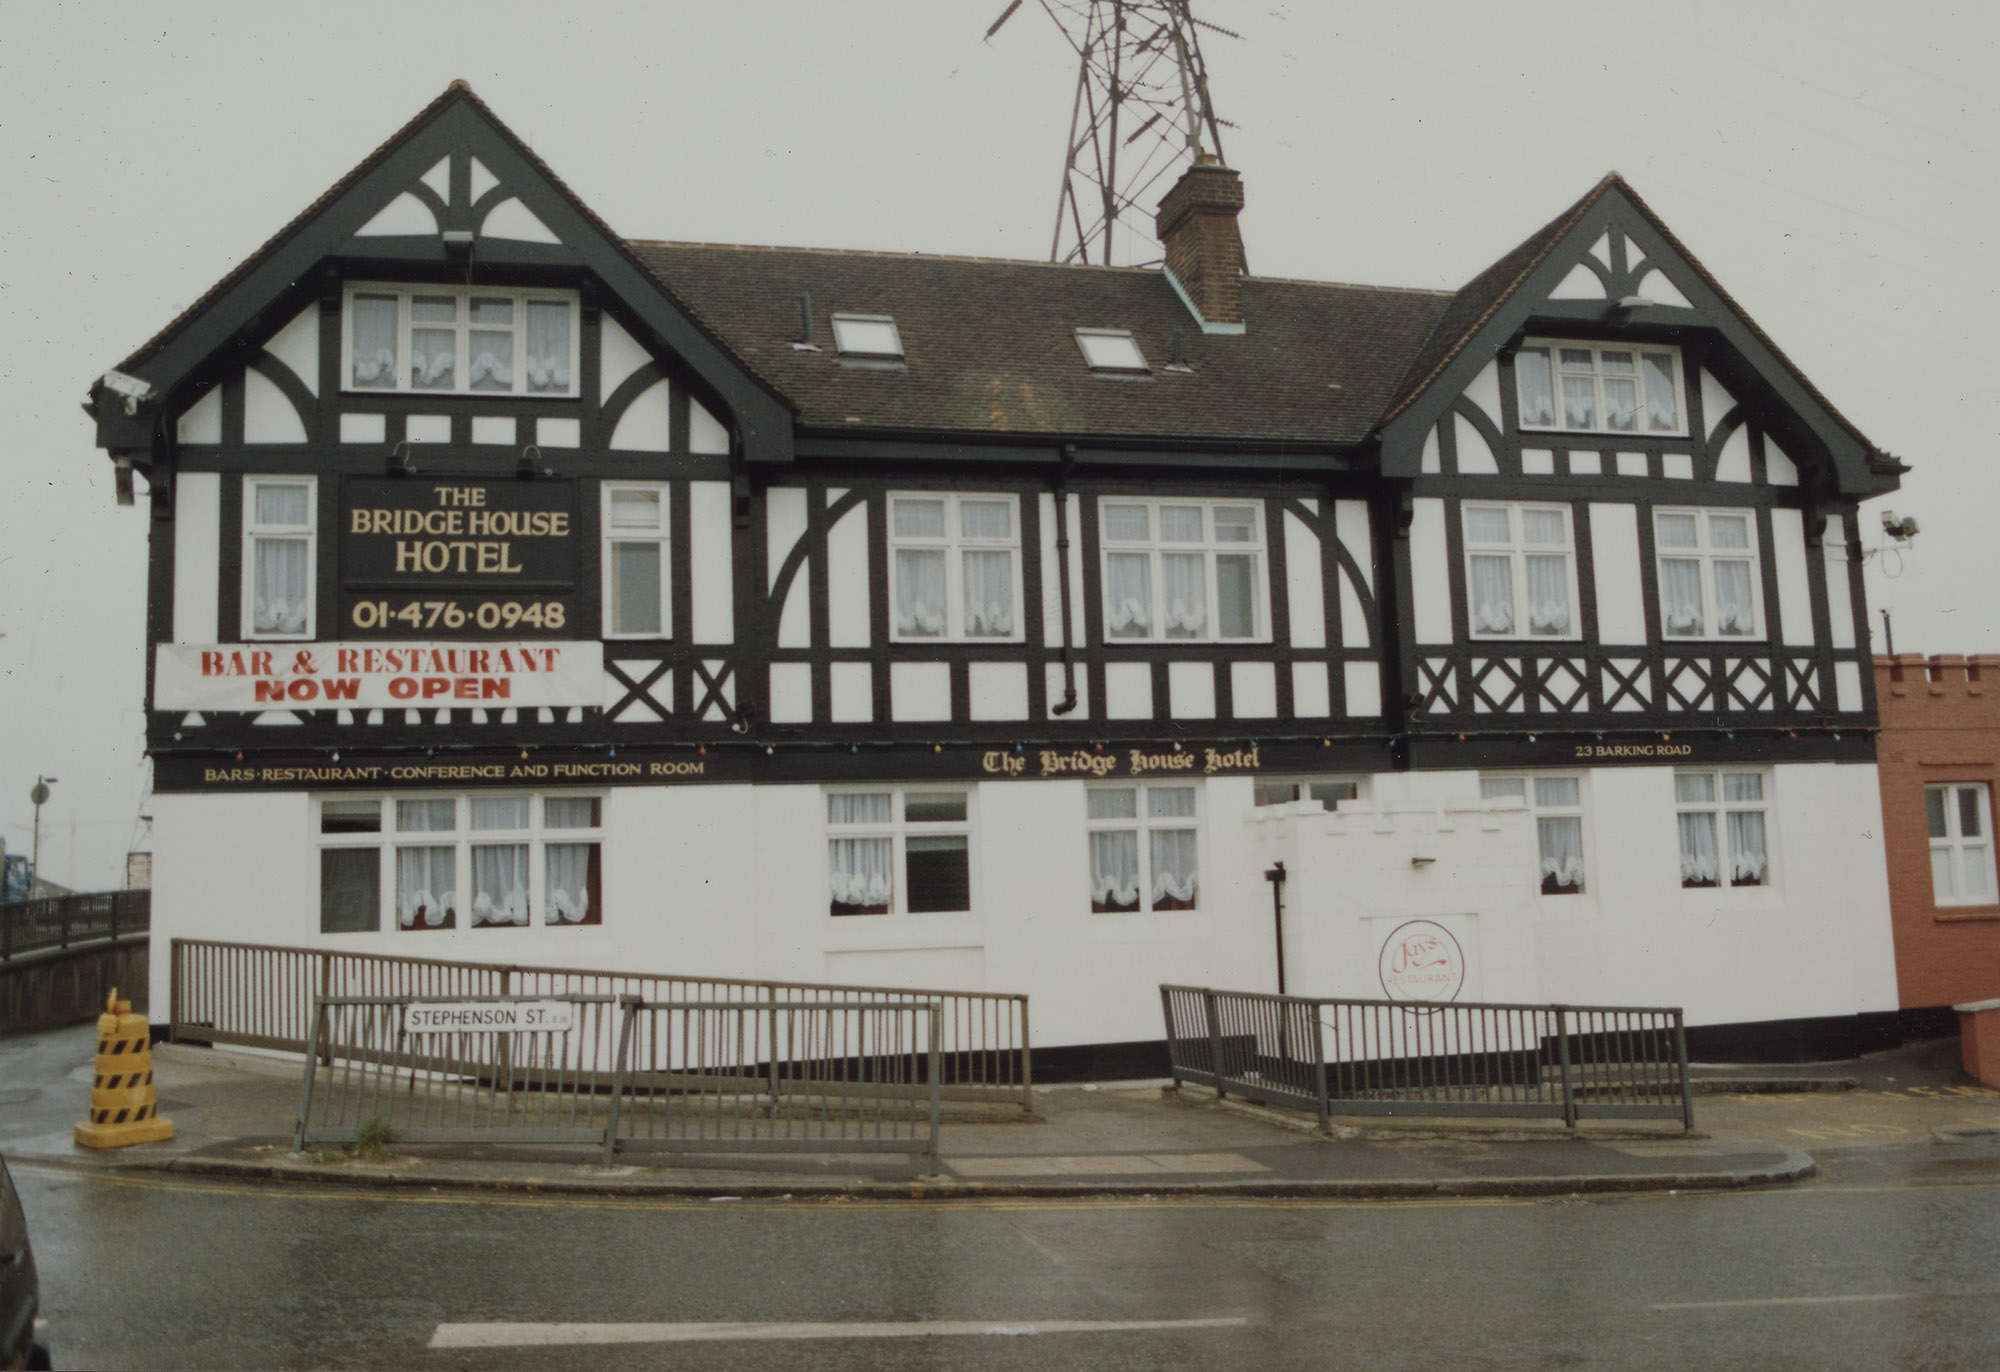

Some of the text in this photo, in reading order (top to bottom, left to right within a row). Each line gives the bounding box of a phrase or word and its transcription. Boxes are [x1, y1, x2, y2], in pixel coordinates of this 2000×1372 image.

[434, 487, 486, 507] THE
[351, 509, 570, 536] BRIDGE HOUSE
[395, 541, 522, 573] HOTEL
[201, 648, 561, 677] BAR & RESTAURANT
[254, 677, 511, 702] NOW OPEN
[982, 751, 1026, 776] The
[1040, 750, 1116, 776] Bridge
[1575, 745, 1692, 757] 23 BARKING ROAD
[205, 762, 705, 782] BARS RESTAURANT CONFERENCE AND FUNCTION ROOM
[411, 1010, 517, 1025] STEPHENSON
